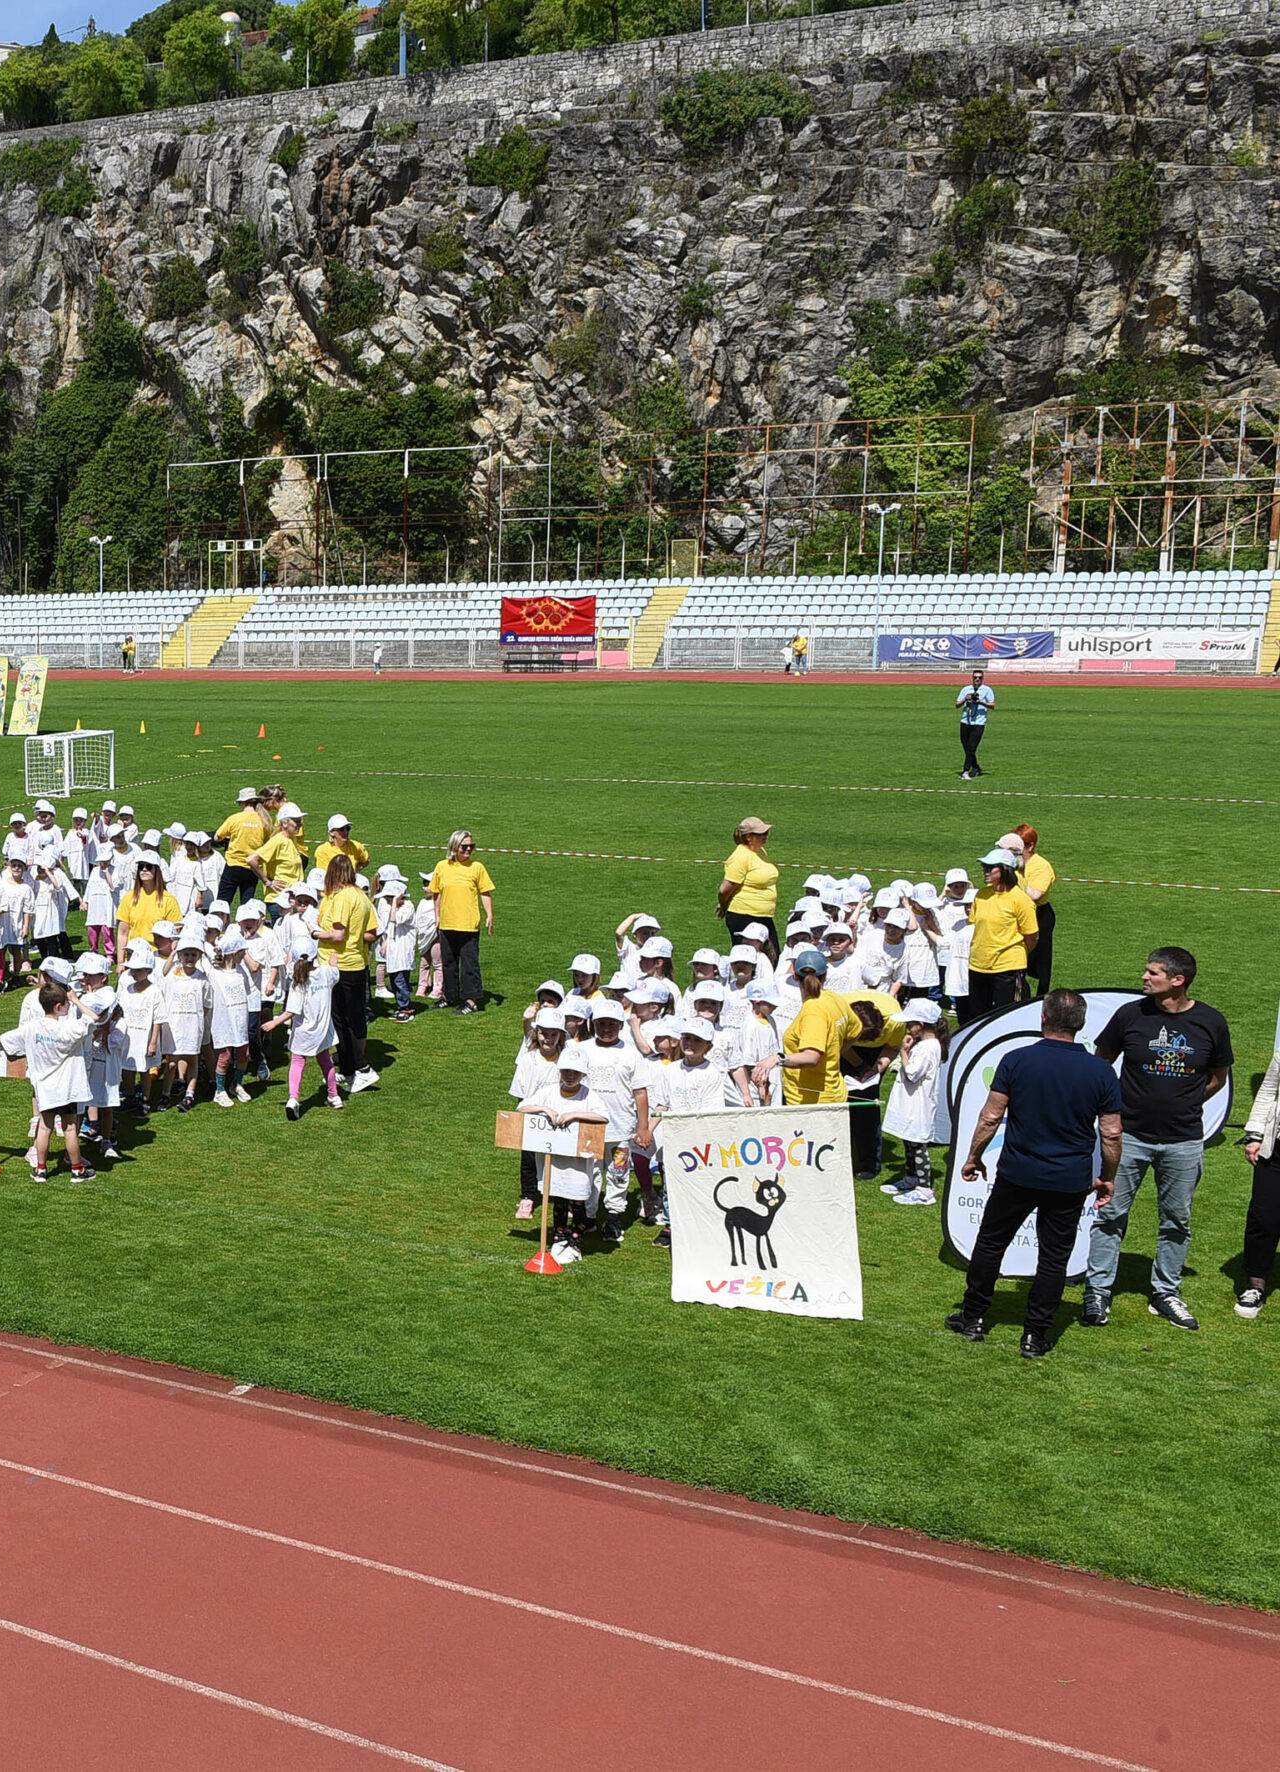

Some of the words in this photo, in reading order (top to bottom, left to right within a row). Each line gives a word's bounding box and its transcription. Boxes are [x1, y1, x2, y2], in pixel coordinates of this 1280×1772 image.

[900, 638, 936, 651] PSK
[1068, 637, 1152, 655] uhlsport
[46, 743, 52, 754] 3
[1142, 1063, 1196, 1074] OLIMPIJADA
[1155, 1059, 1186, 1067] DJEČJA
[545, 1142, 553, 1152] 3
[718, 1130, 837, 1172] MORČIĆ
[706, 1276, 809, 1302] VEŽICA
